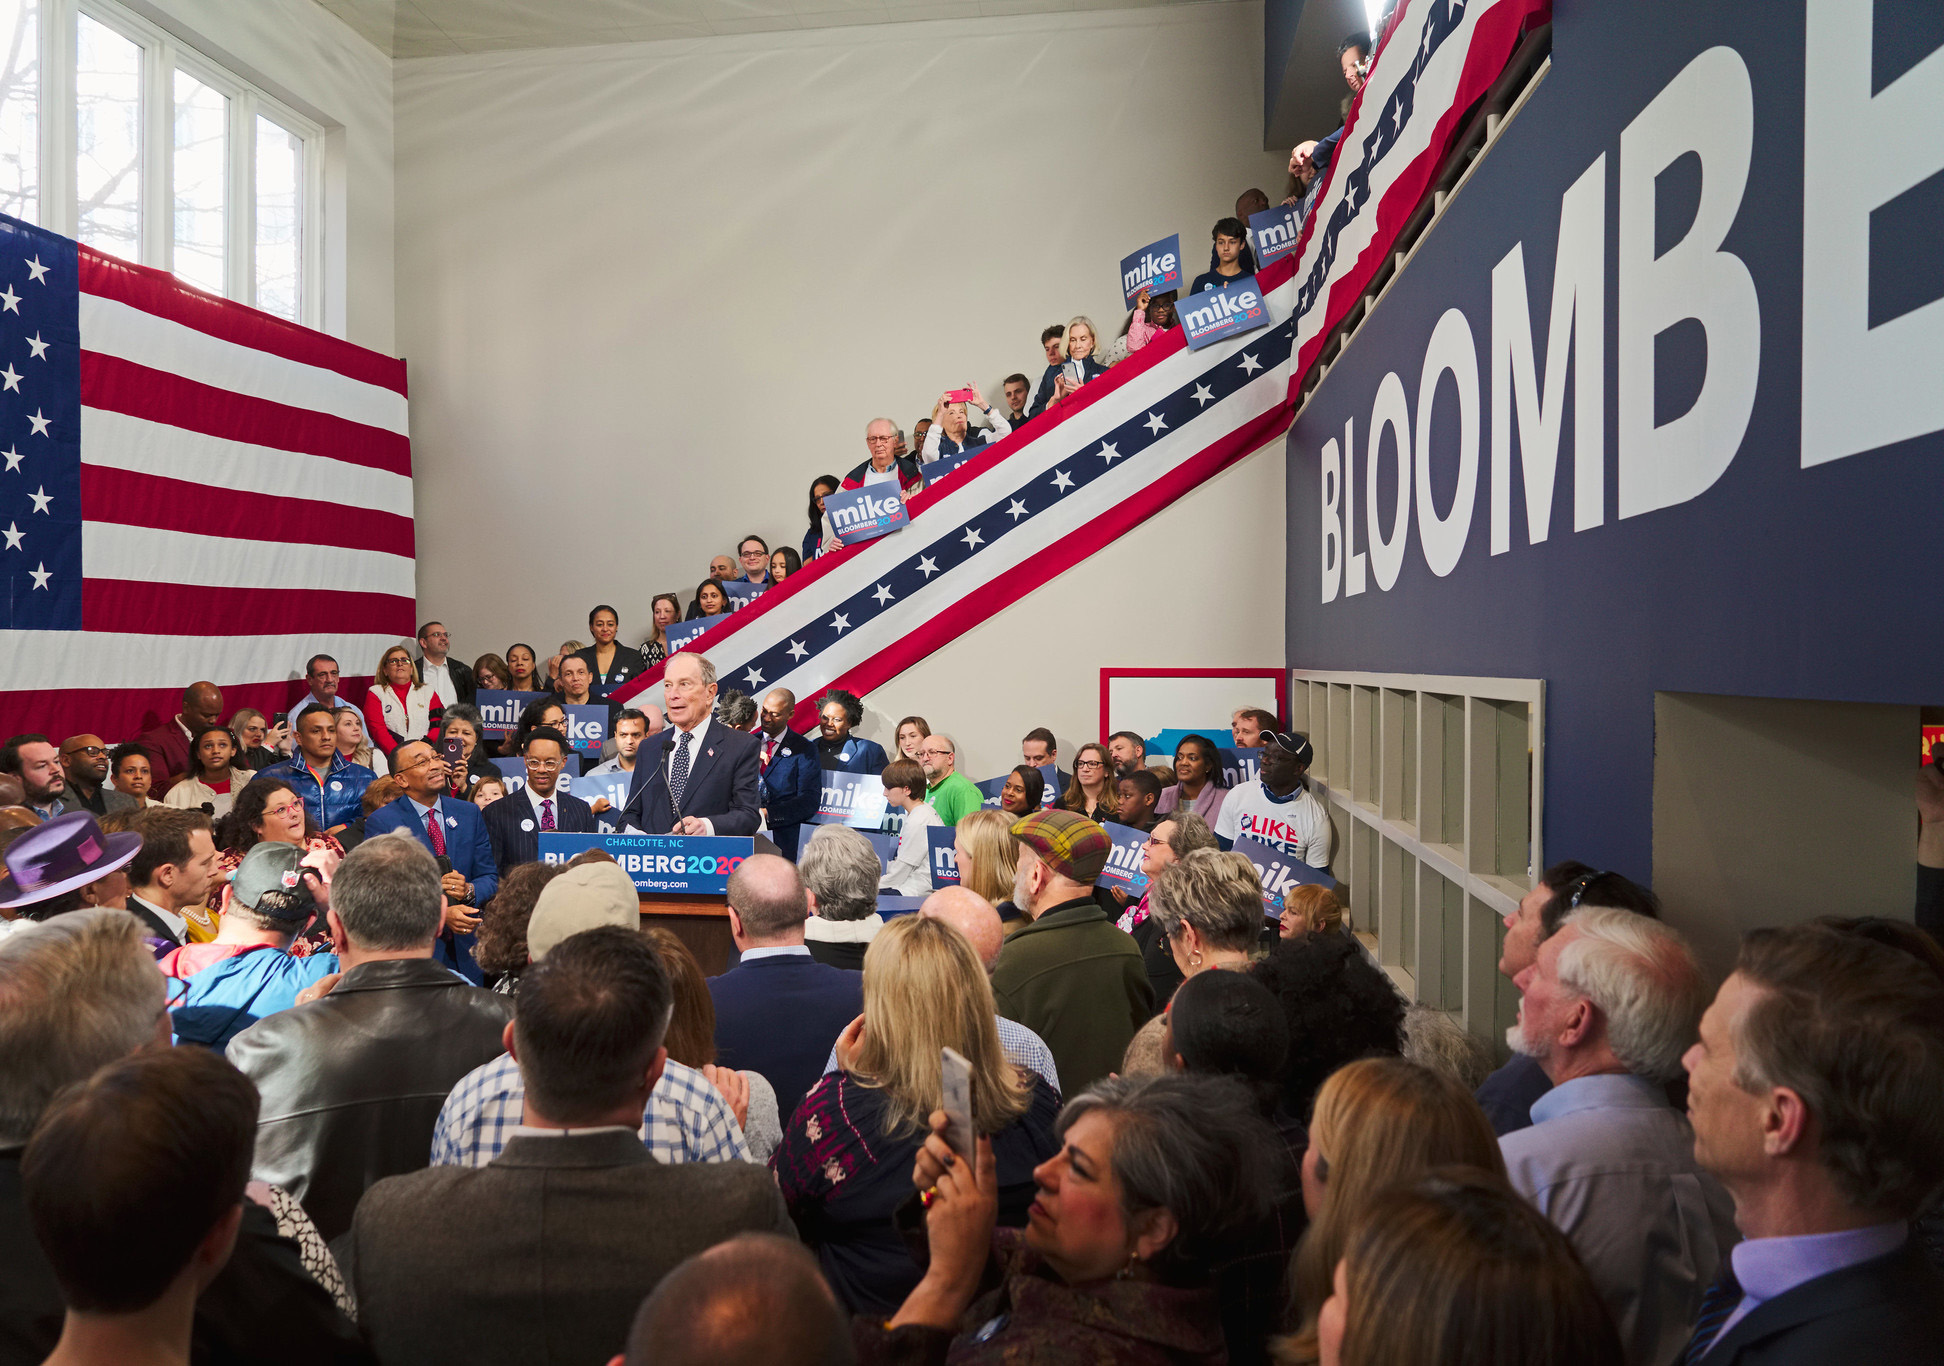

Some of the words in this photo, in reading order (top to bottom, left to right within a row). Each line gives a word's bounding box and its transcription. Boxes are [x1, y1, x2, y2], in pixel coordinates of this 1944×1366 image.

[1125, 253, 1176, 291] mike
[1185, 291, 1257, 330] mike
[833, 495, 900, 528] mike
[568, 714, 602, 739] ke
[605, 837, 667, 848] CHARLOTTE,
[669, 839, 684, 848] NC
